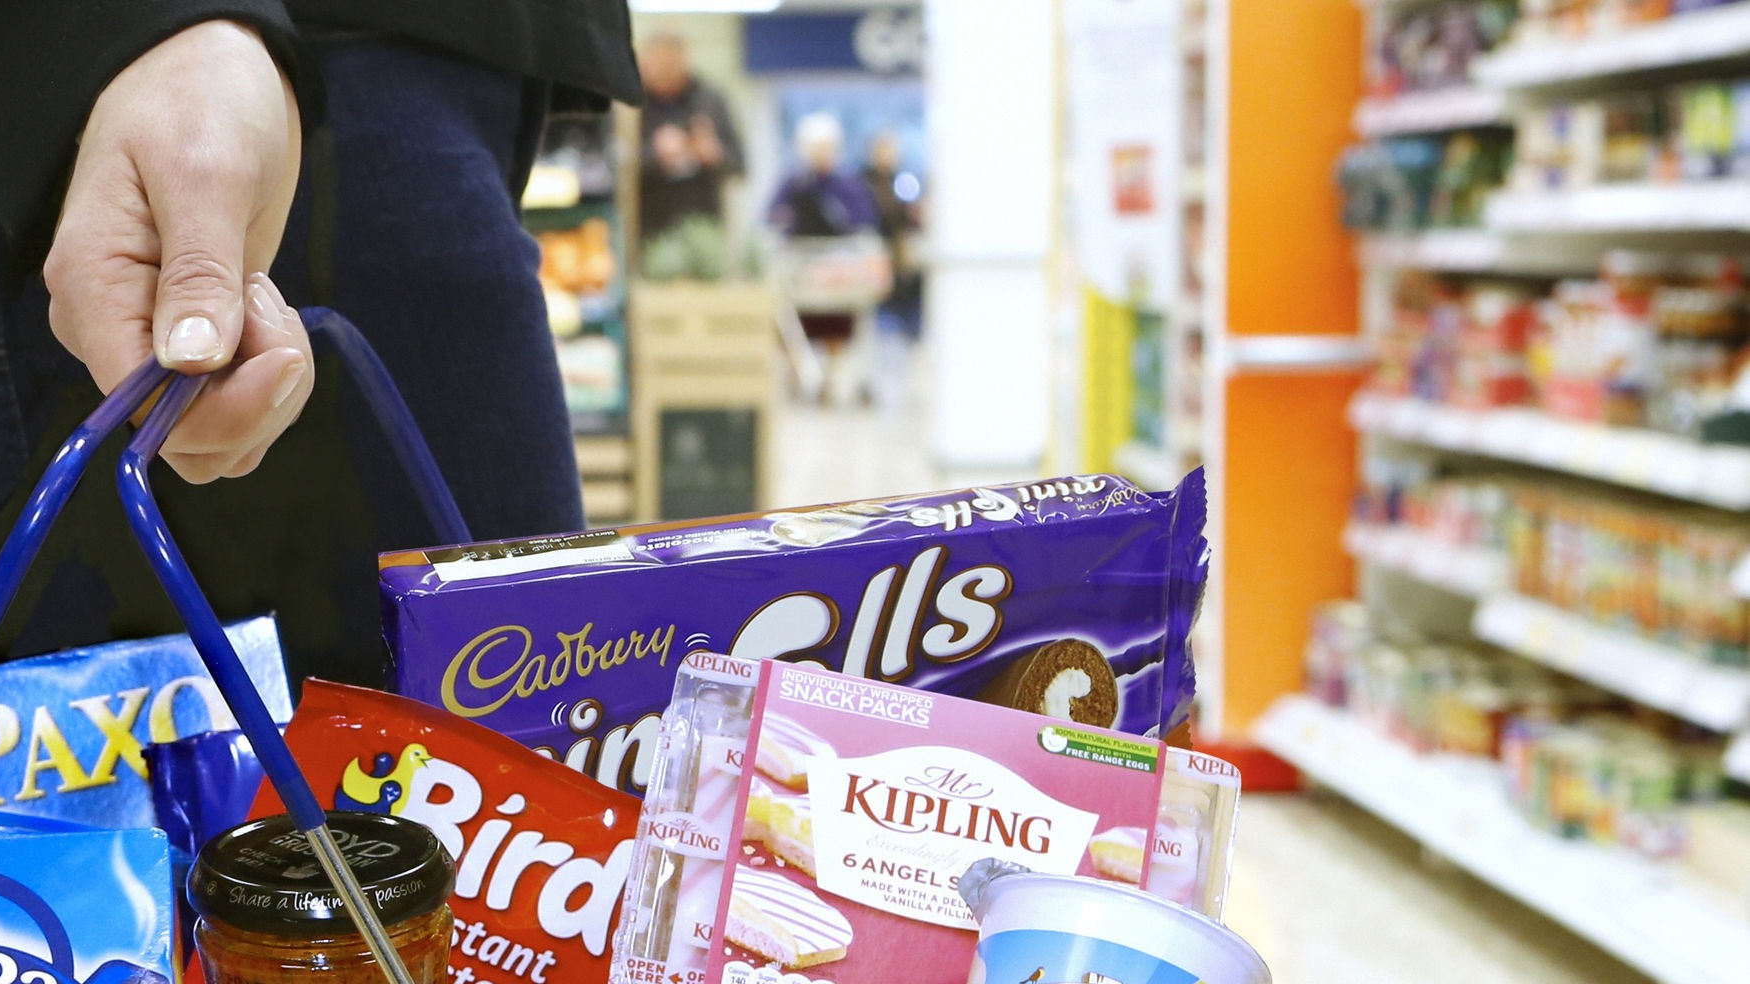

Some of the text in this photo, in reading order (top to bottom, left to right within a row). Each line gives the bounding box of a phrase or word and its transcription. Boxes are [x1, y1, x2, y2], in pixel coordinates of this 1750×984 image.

[636, 537, 721, 552] Chocolate
[728, 543, 1014, 681] lls
[440, 622, 676, 718] Cadbury
[682, 653, 753, 679] KIPLING
[779, 680, 930, 724] SNACK PACKS
[782, 670, 933, 710] INDIVIDUALLY WRAPPED
[1077, 732, 1111, 746] NATURAL
[1065, 748, 1150, 771] FREE RANGE EGGS
[1188, 755, 1240, 778] KIPLI
[841, 772, 1052, 855] KIPLING
[647, 820, 721, 852] KIPLING
[842, 853, 942, 888] 6 ANGEL
[229, 878, 427, 911] Share a lifetim passion
[861, 879, 939, 902] MADE WITH A
[883, 894, 974, 921] VANILLA FILLIN
[450, 917, 557, 984] stant
[623, 969, 664, 984] HERE
[626, 958, 666, 974] OPEN
